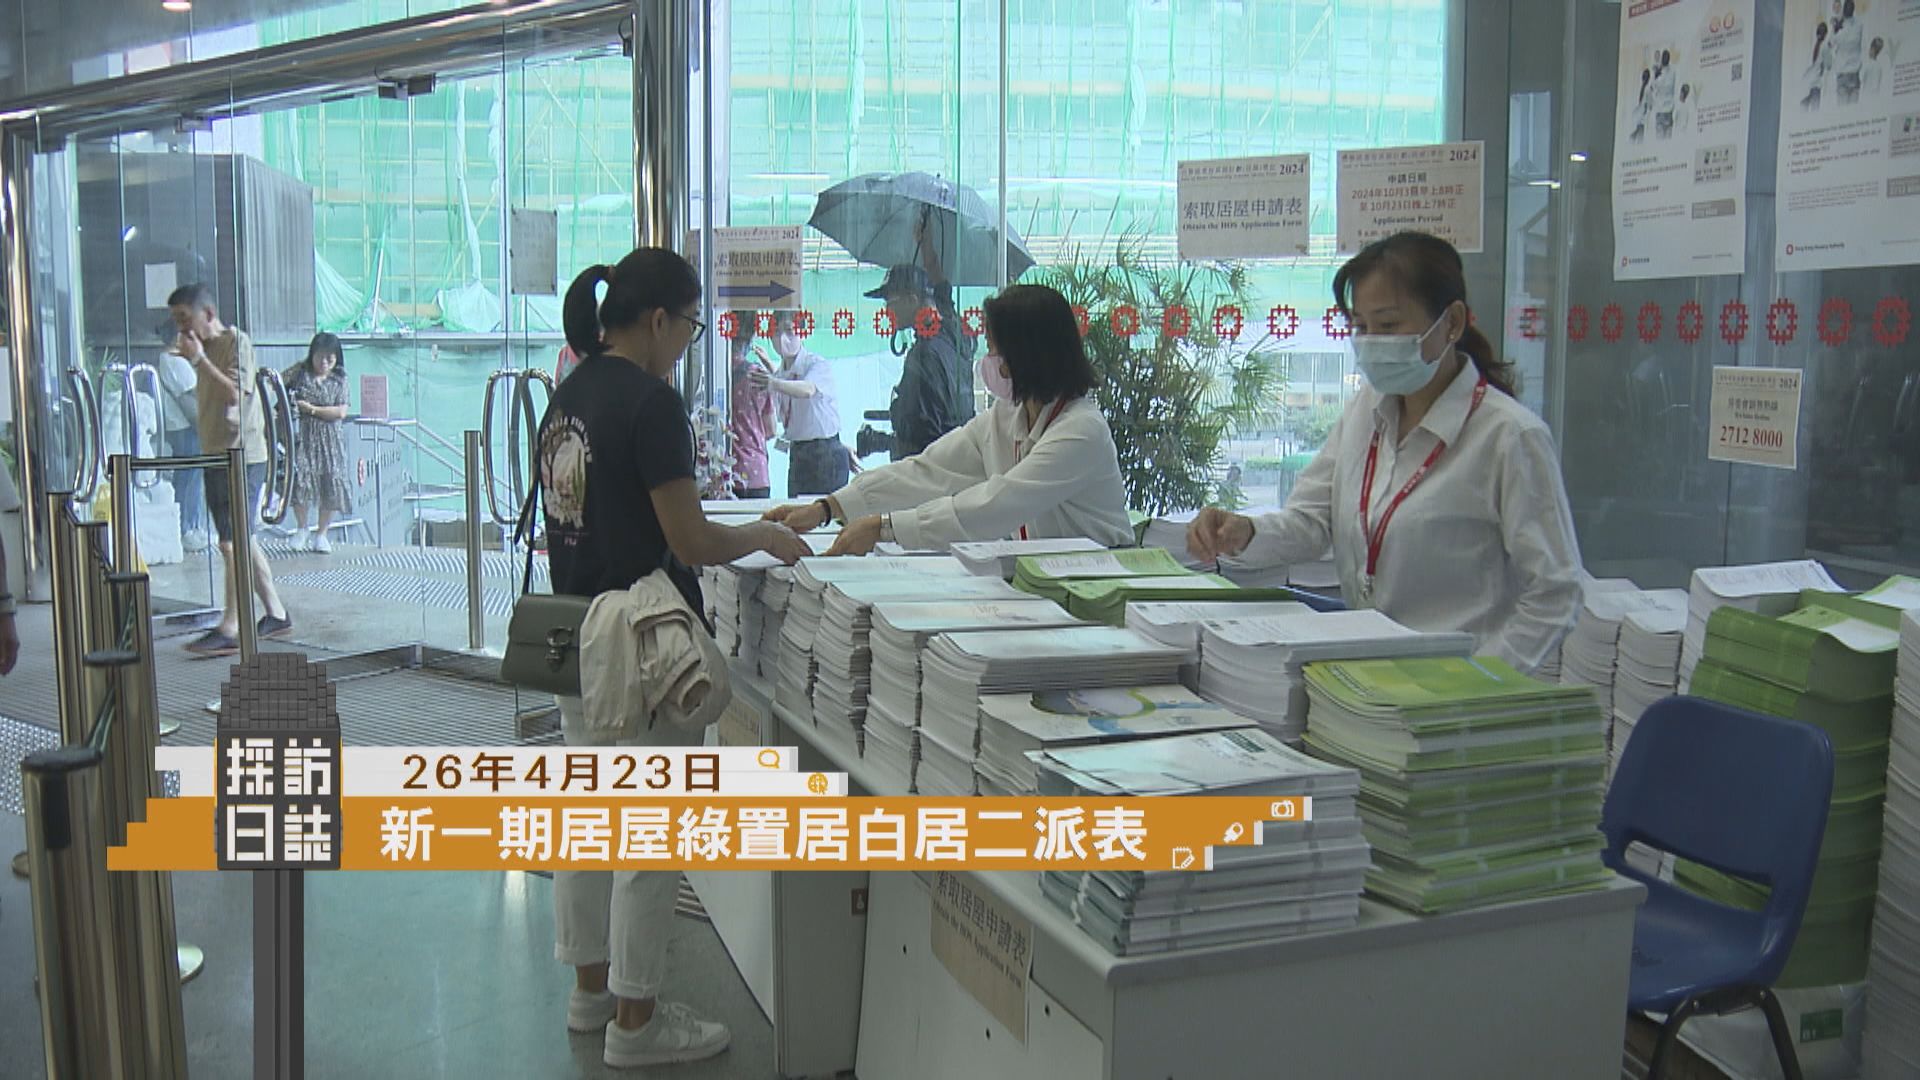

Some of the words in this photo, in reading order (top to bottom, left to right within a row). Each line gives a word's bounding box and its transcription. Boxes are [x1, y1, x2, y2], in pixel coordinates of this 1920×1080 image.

[1449, 149, 1476, 161] 2024
[1280, 164, 1304, 175] 2024
[1388, 172, 1427, 184] 申請日期
[1183, 197, 1302, 220] 索取居屋申請表
[1241, 219, 1280, 231] Application
[1374, 215, 1416, 225] Application
[1419, 214, 1443, 222] Period
[782, 230, 799, 239] 2024
[1720, 425, 1749, 443] 2712
[1752, 428, 1783, 448] 8000
